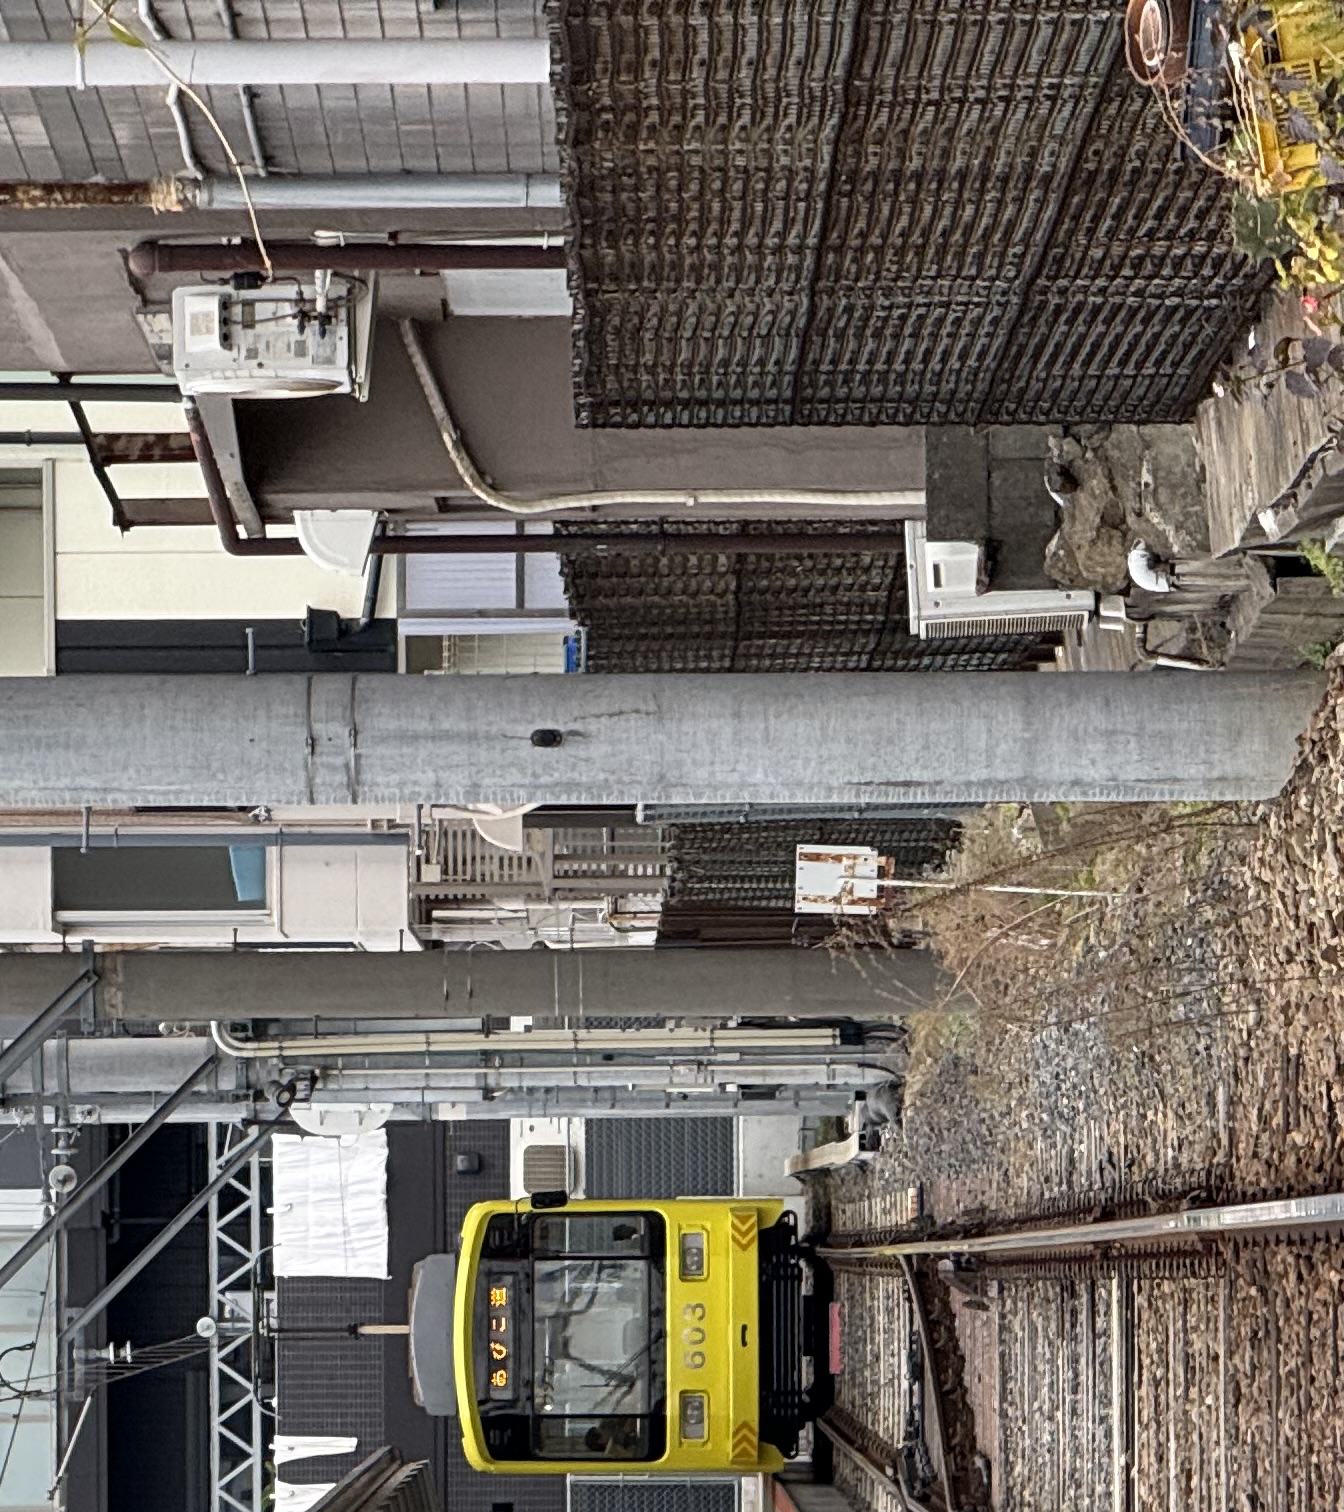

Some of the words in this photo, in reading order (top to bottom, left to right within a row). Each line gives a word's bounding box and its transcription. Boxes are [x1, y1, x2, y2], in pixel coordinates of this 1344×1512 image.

[489, 1287, 507, 1387] あびこ道
[682, 1302, 706, 1370] 603
